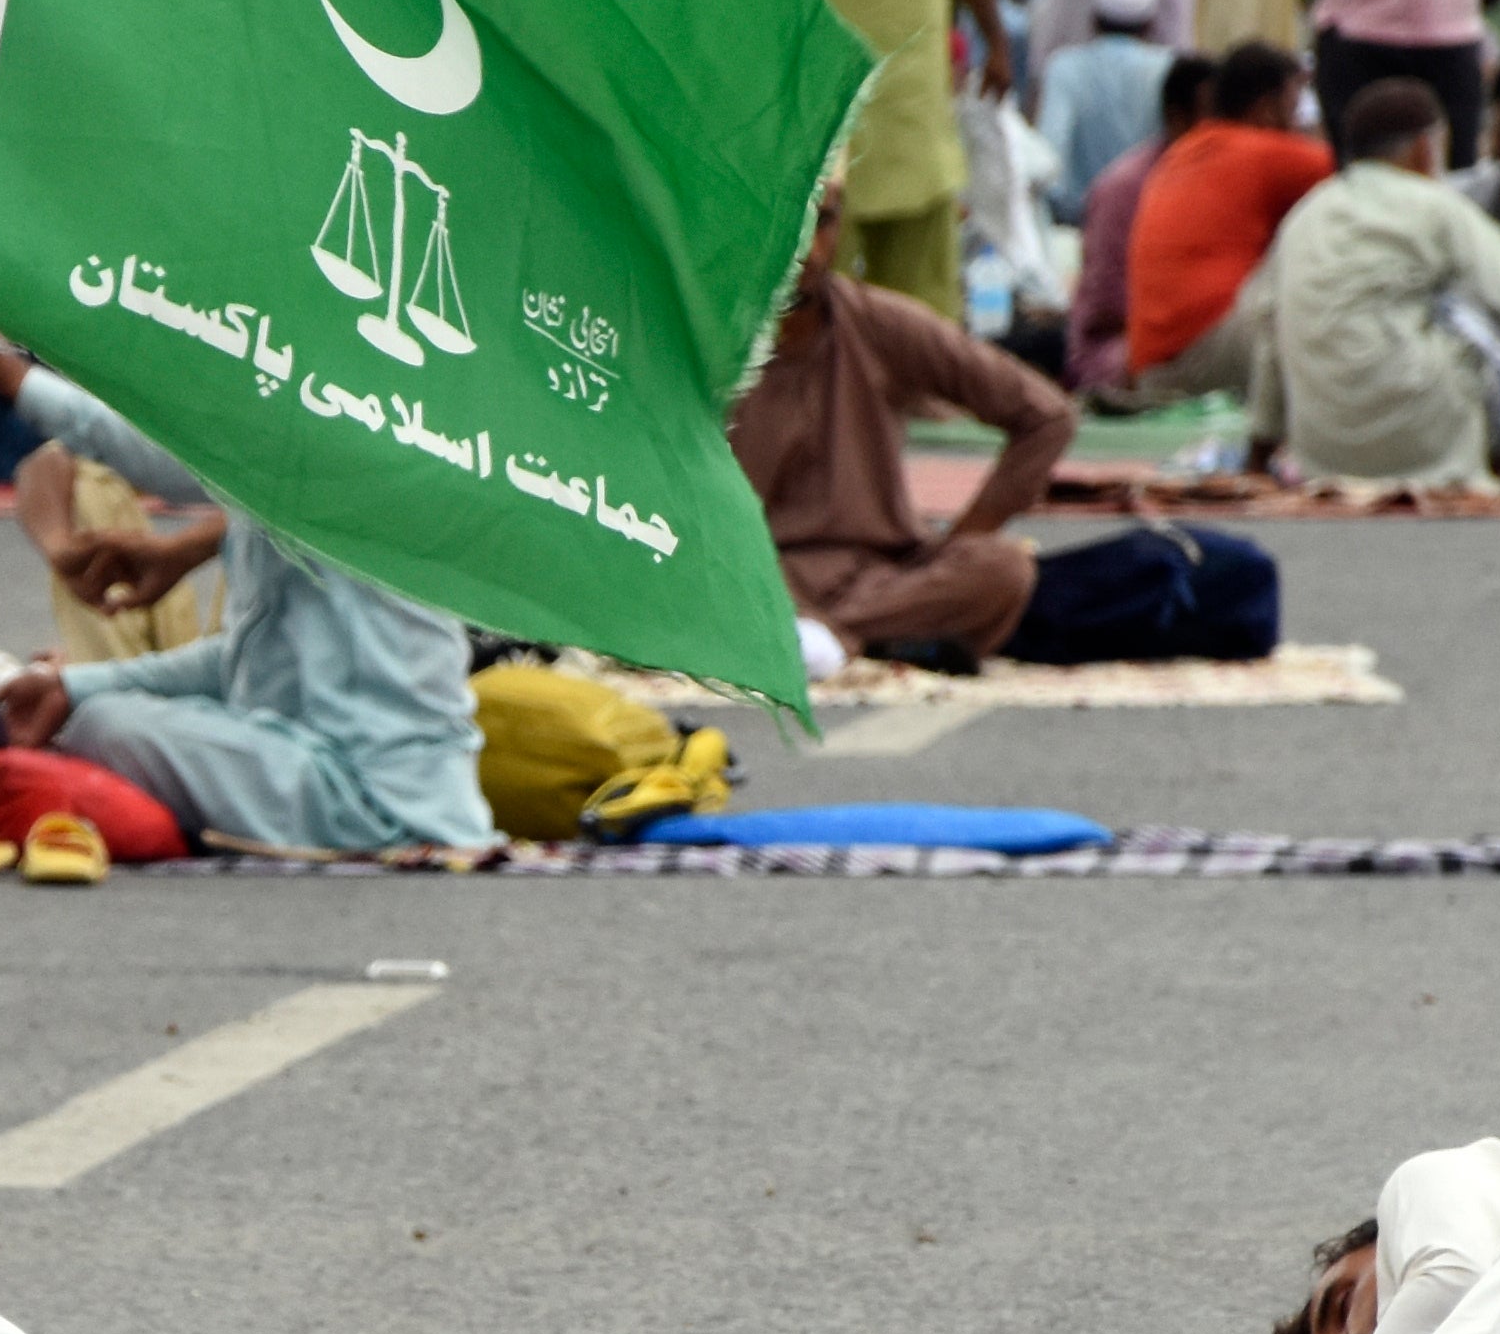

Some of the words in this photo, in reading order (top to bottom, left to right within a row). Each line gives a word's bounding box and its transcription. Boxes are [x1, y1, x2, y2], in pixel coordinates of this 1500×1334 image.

[69, 254, 294, 397] پاکستان
[300, 371, 493, 480] اسلامی
[505, 451, 680, 564] جماعت
